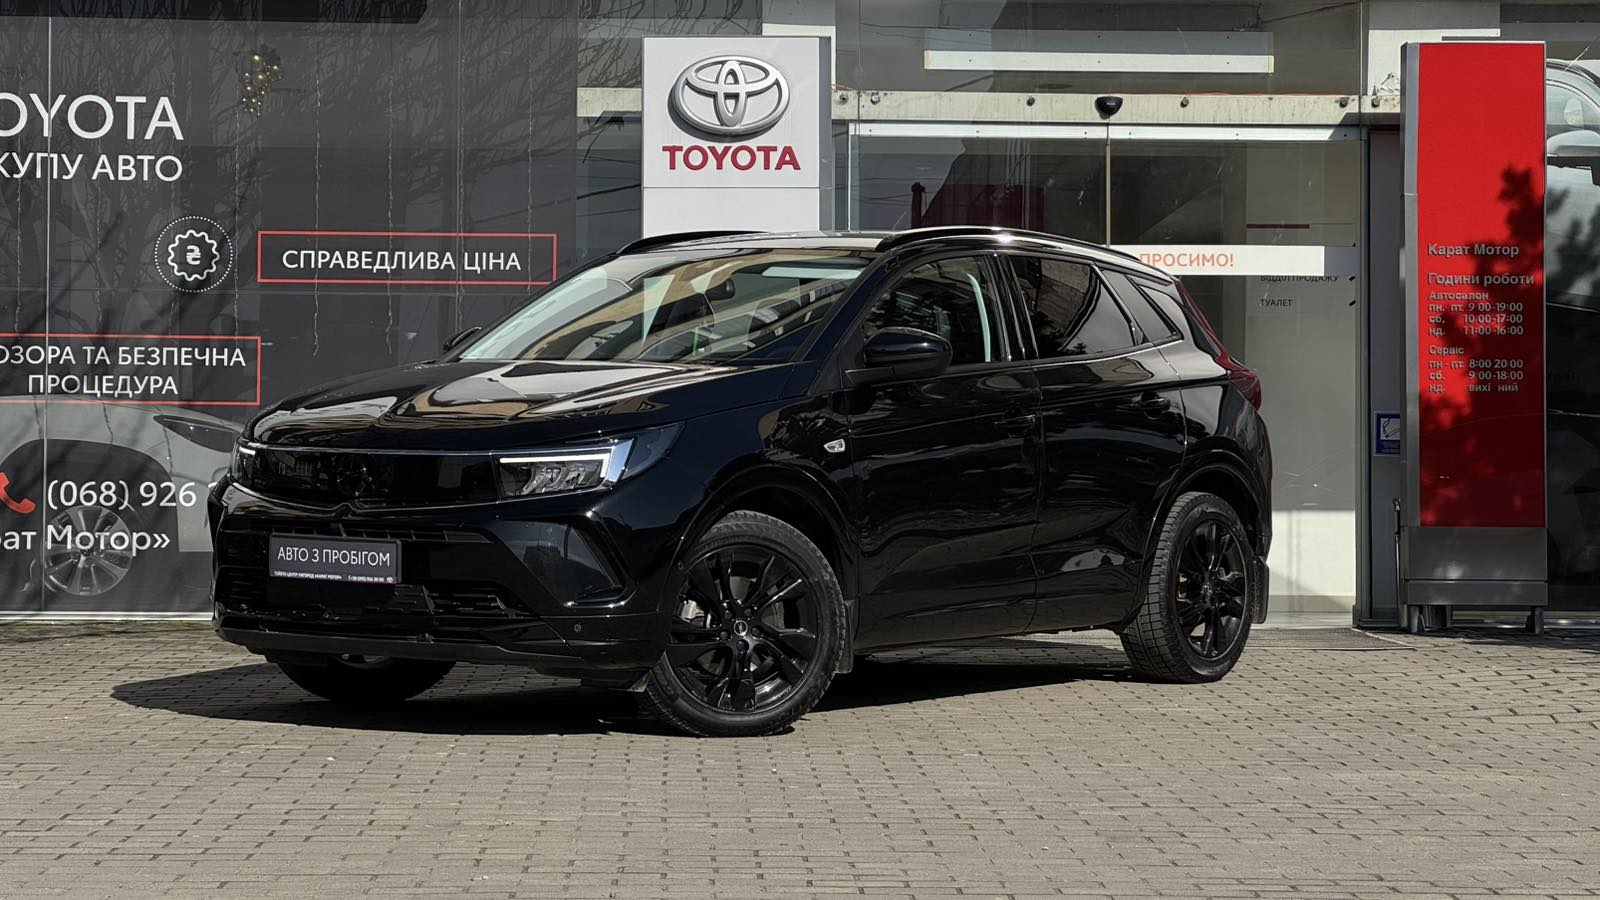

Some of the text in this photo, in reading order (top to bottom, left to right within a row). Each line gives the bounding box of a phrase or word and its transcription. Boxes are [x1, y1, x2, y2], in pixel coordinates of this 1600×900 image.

[91, 153, 183, 182] АВТО
[662, 145, 801, 171] TOYOTA
[1428, 243, 1520, 257] Карат Мотор
[283, 251, 521, 274] СПРАВЕДЛИВА ЦІНА
[1140, 253, 1234, 267] ПРОСИМО!
[1428, 273, 1534, 287] Години роботи
[1260, 299, 1292, 307] ТУАЛЕТ
[1429, 292, 1489, 301] Автосалон
[83, 347, 110, 364] ТА
[119, 347, 245, 366] БЕЗПЕЧНА
[1429, 345, 1464, 355] Сервіс
[28, 374, 178, 398] ПРОЦЕДУРА
[47, 480, 197, 510] (068) 926
[0, 524, 171, 557] ат Мотор»
[278, 547, 308, 561] АВТО
[323, 550, 389, 566] ПРОБІГОМ
